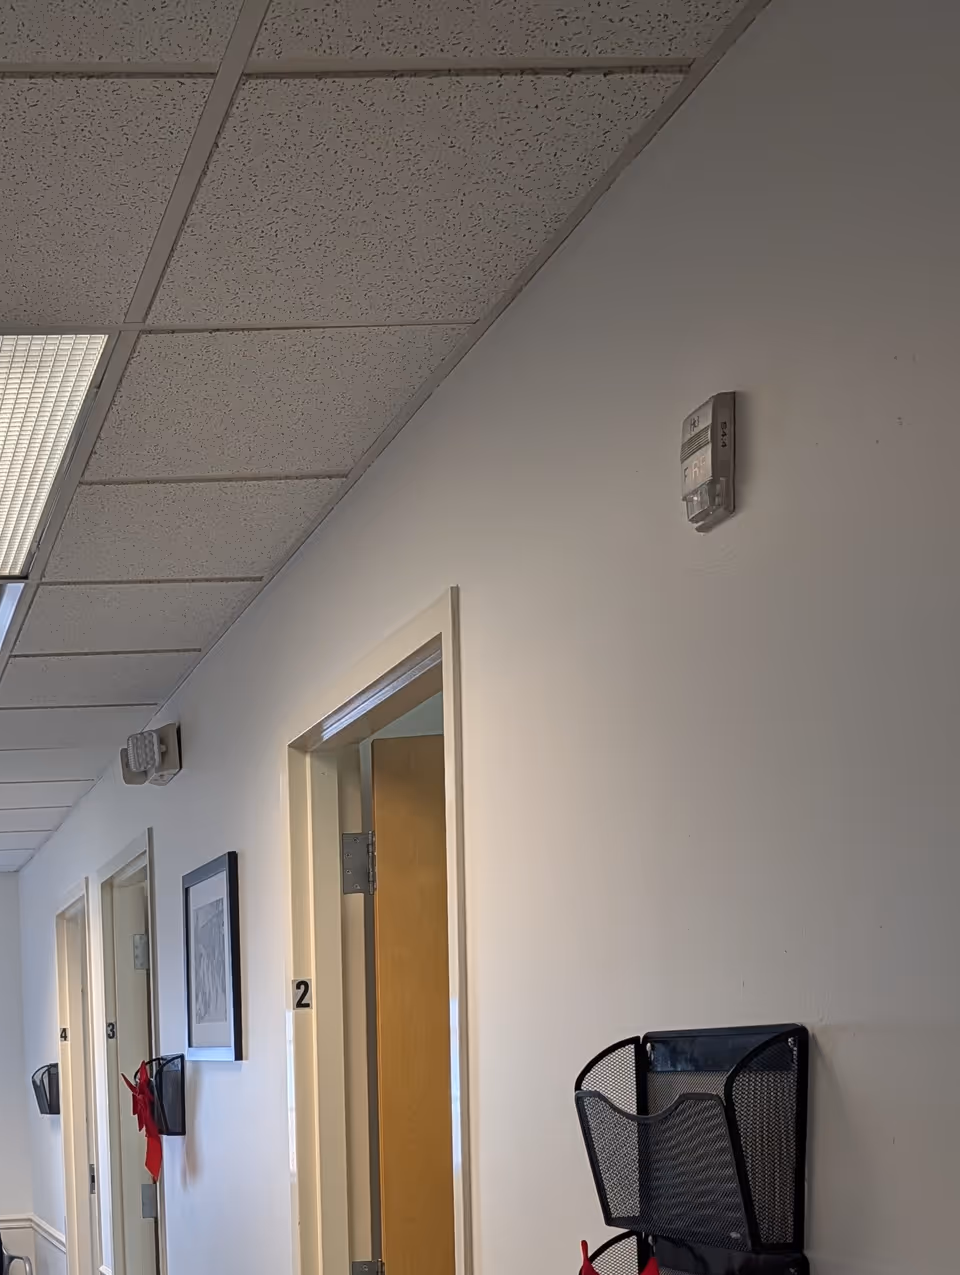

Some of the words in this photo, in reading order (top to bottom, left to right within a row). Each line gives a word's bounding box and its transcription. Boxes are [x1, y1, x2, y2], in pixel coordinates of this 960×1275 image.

[683, 455, 706, 483] FRE
[295, 980, 311, 1008] 2
[59, 1028, 68, 1042] 4
[106, 1022, 116, 1040] 3
